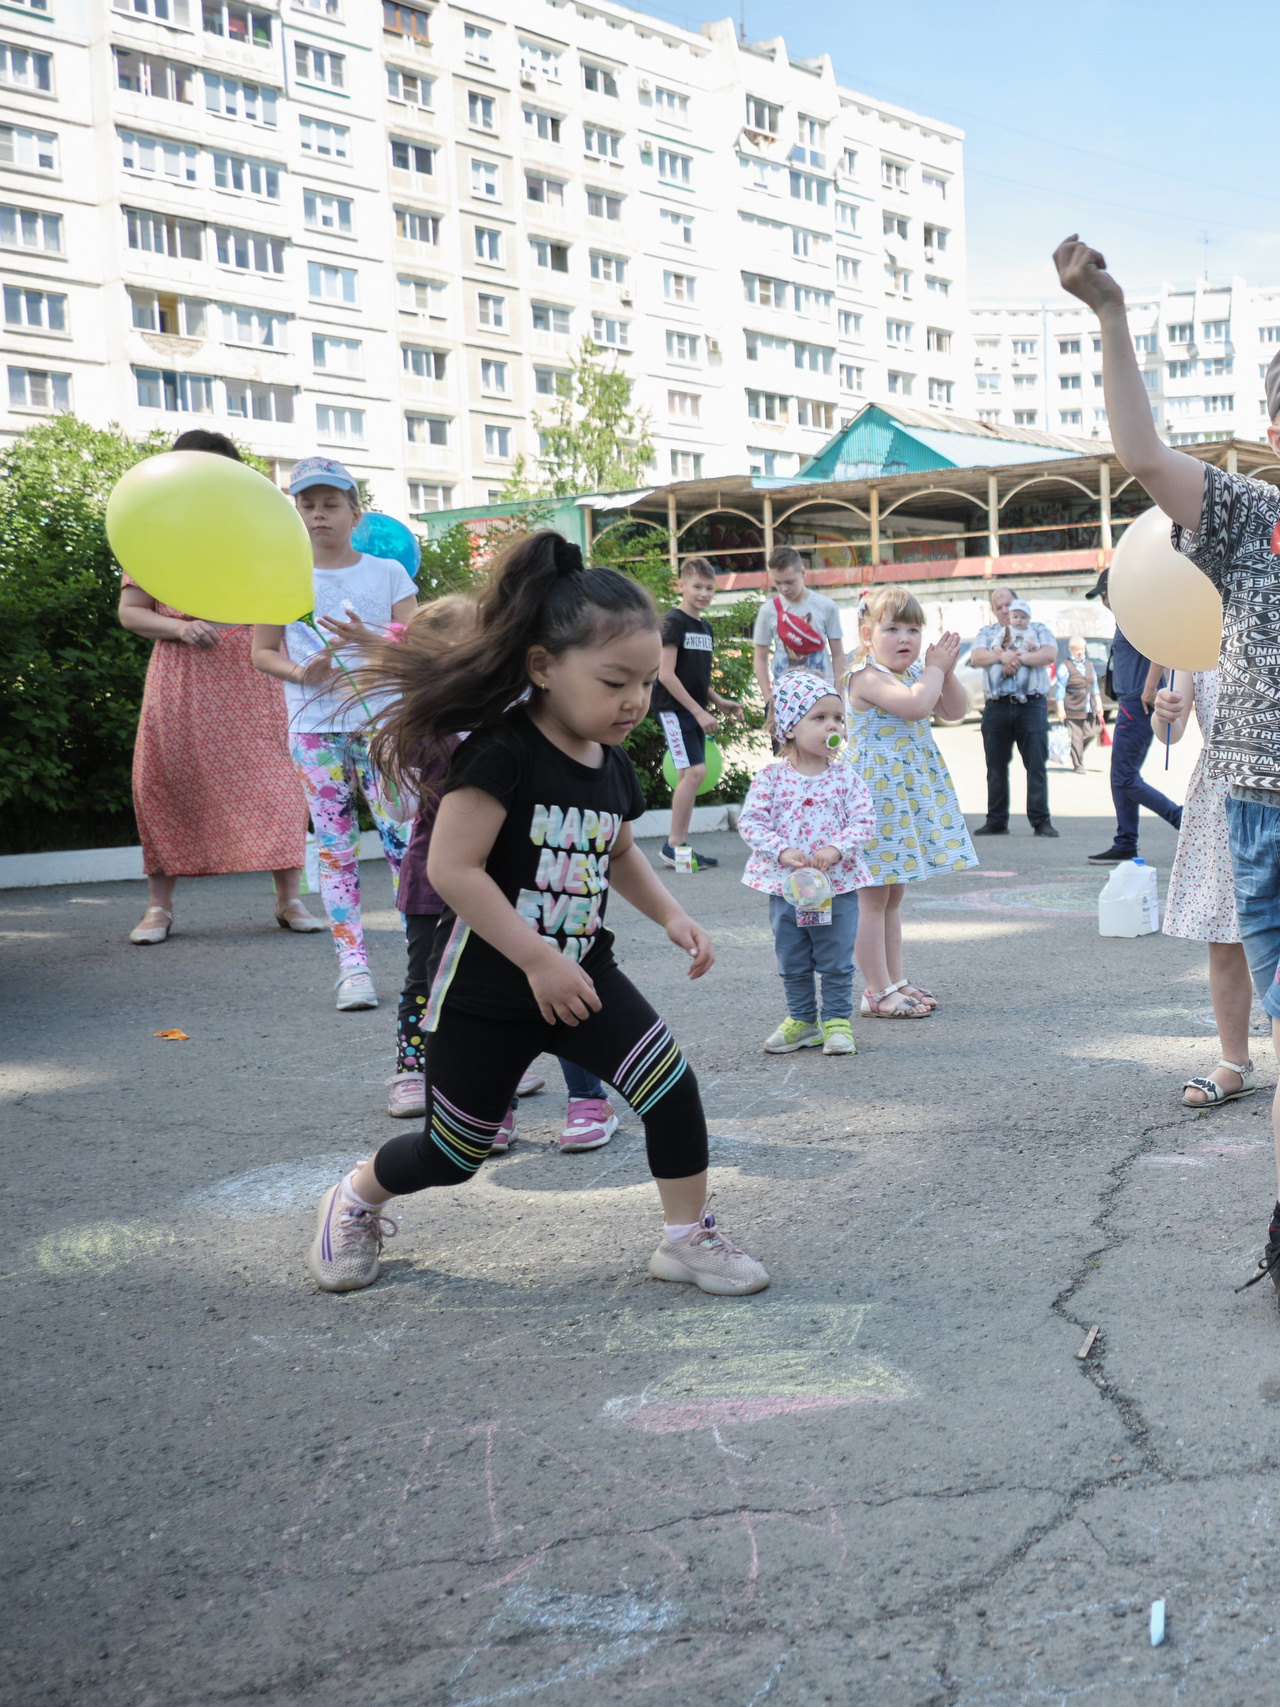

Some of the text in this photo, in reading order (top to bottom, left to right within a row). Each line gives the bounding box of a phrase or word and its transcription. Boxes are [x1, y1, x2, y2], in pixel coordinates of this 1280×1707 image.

[1210, 750, 1274, 765] WARNING
[529, 804, 623, 853] HAPPY
[535, 848, 610, 895] NESS
